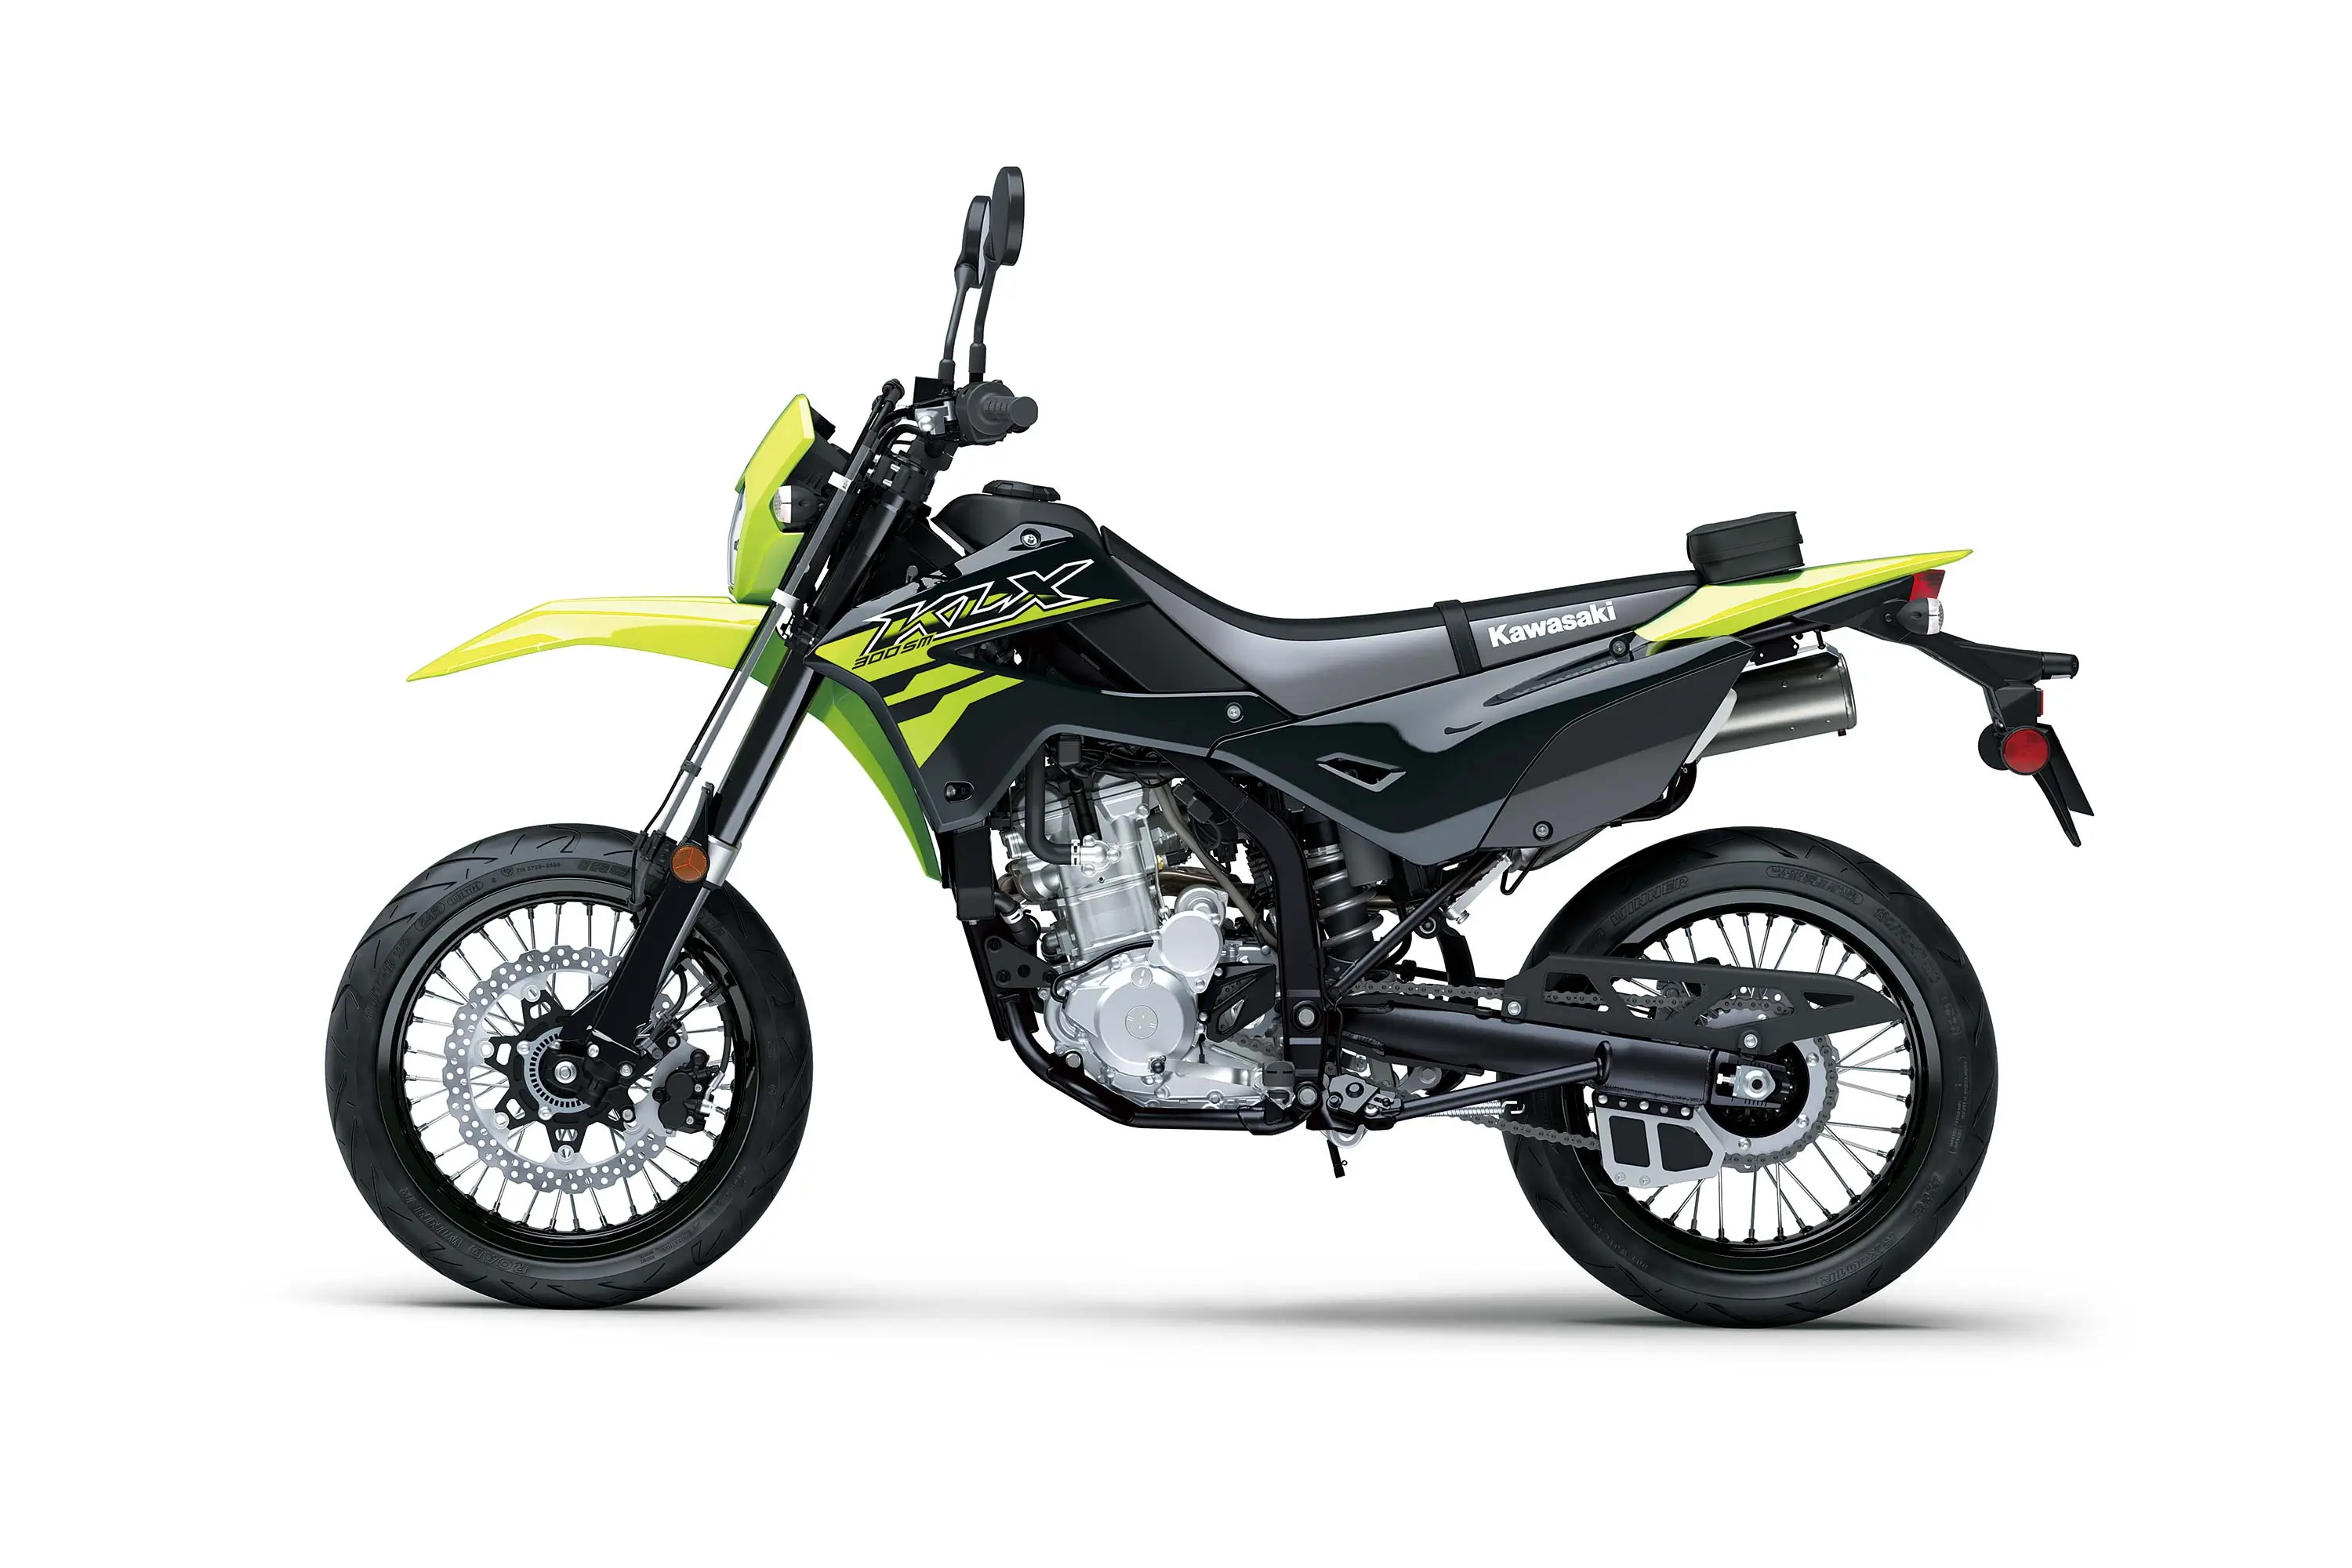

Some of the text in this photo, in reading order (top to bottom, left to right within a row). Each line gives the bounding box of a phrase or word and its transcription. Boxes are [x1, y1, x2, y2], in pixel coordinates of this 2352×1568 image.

[862, 558, 1095, 655] KLX
[1487, 600, 1617, 648] Kawasaki
[851, 632, 938, 670] 300SM
[1607, 873, 1690, 927] WINNER
[466, 1243, 528, 1275] ROAD
